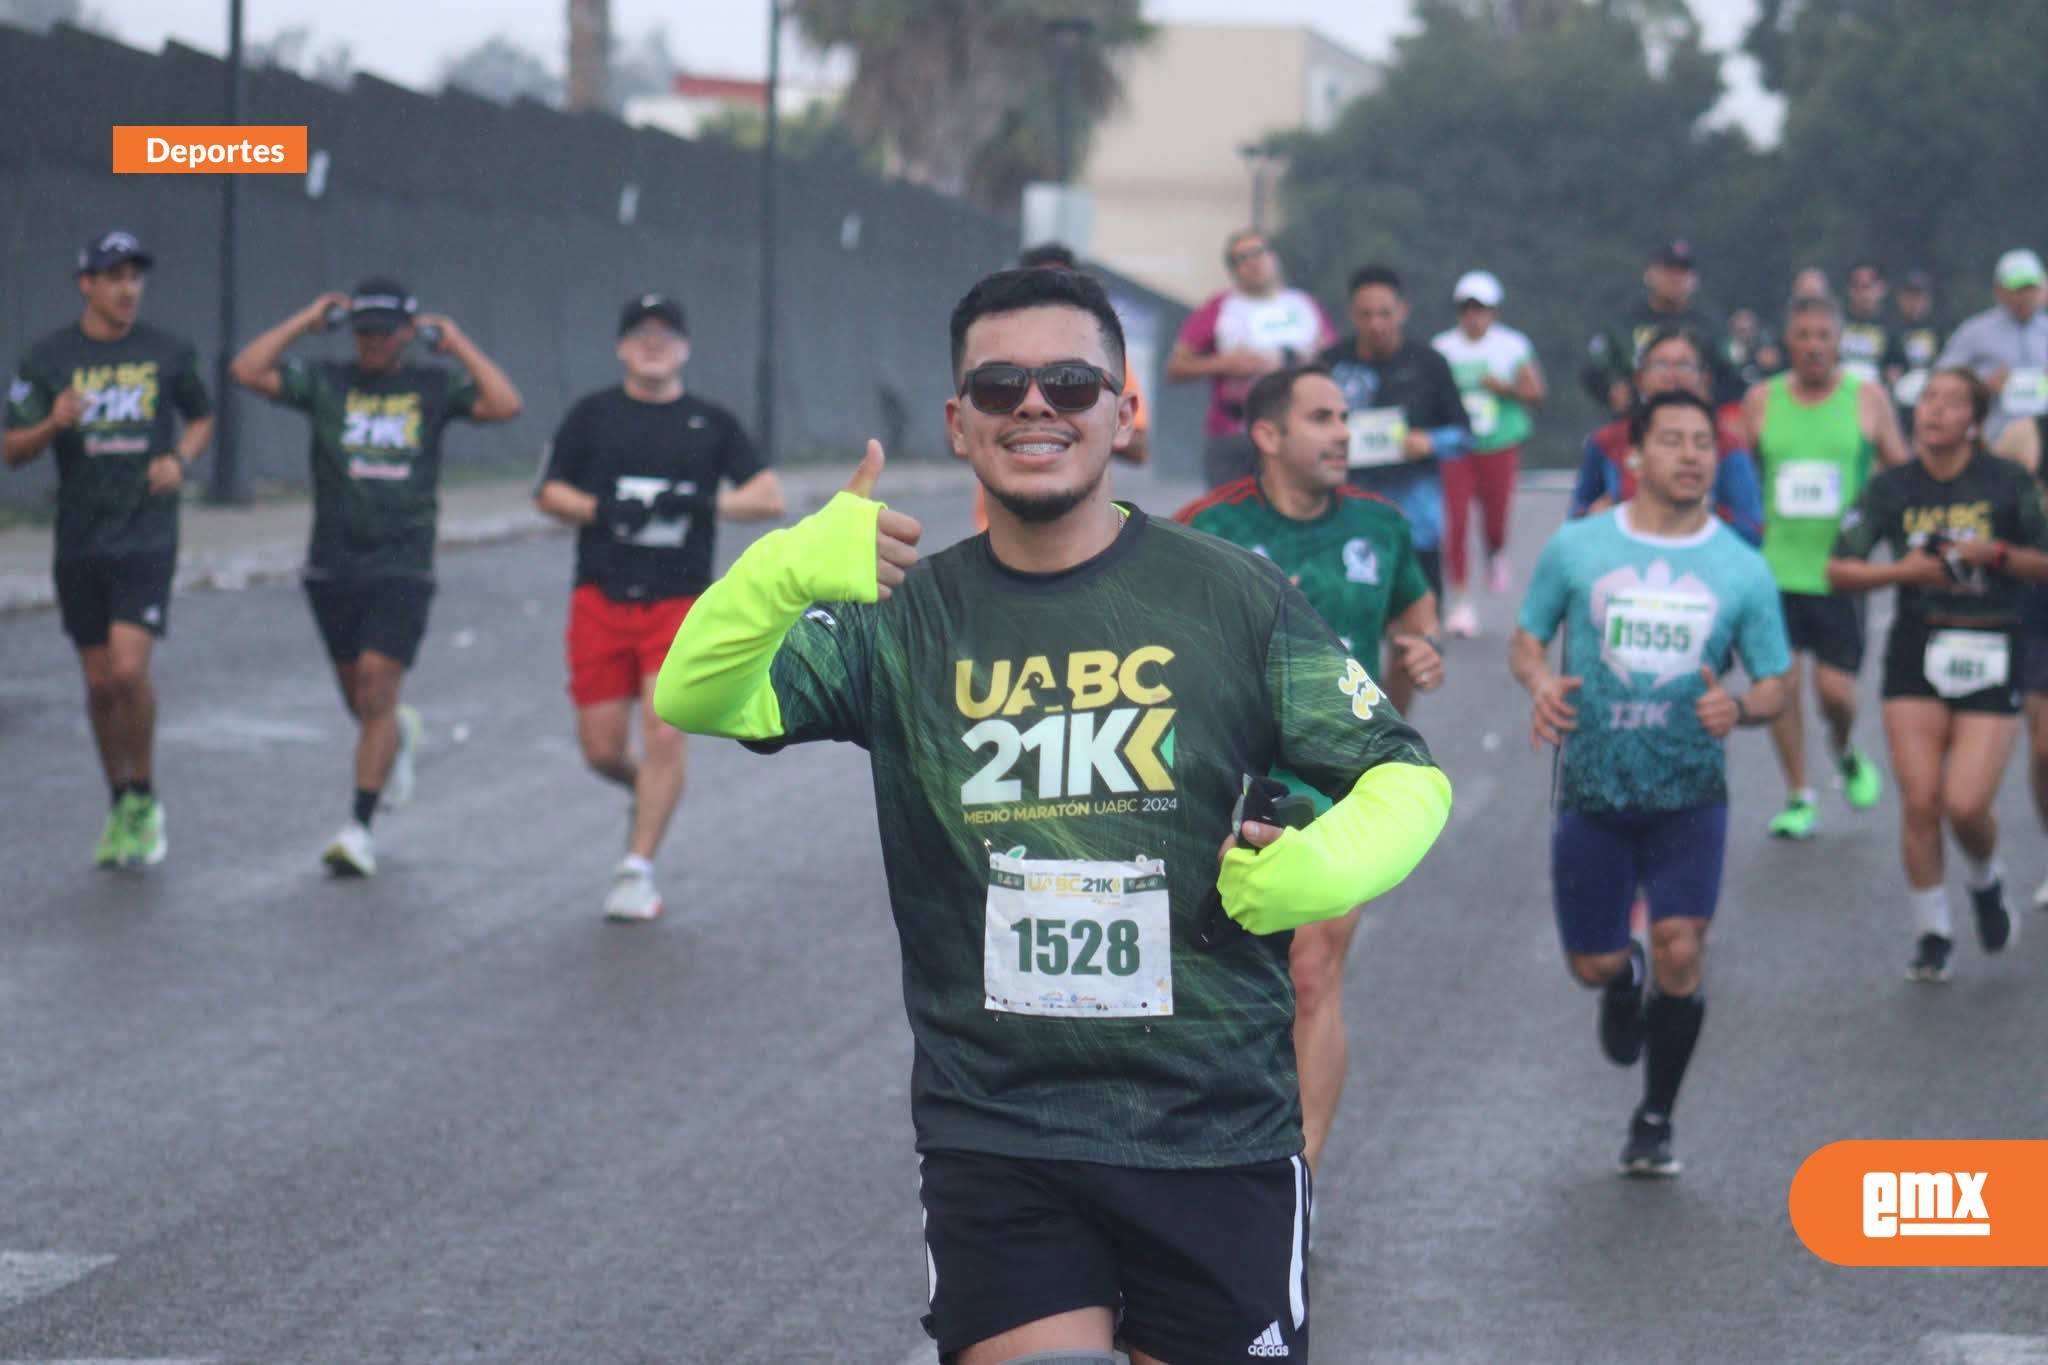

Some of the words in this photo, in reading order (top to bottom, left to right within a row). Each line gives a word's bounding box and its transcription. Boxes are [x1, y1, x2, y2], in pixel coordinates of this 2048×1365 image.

[1623, 620, 1692, 653] 1555
[955, 645, 1175, 719] UABC
[961, 707, 1139, 805] 21K
[964, 808, 1010, 825] MEDIO
[1013, 801, 1090, 821] MARATÓN
[1094, 798, 1138, 815] UABC
[1142, 797, 1178, 812] 2024
[1010, 917, 1140, 976] 1528
[1247, 1344, 1289, 1358] adidas
